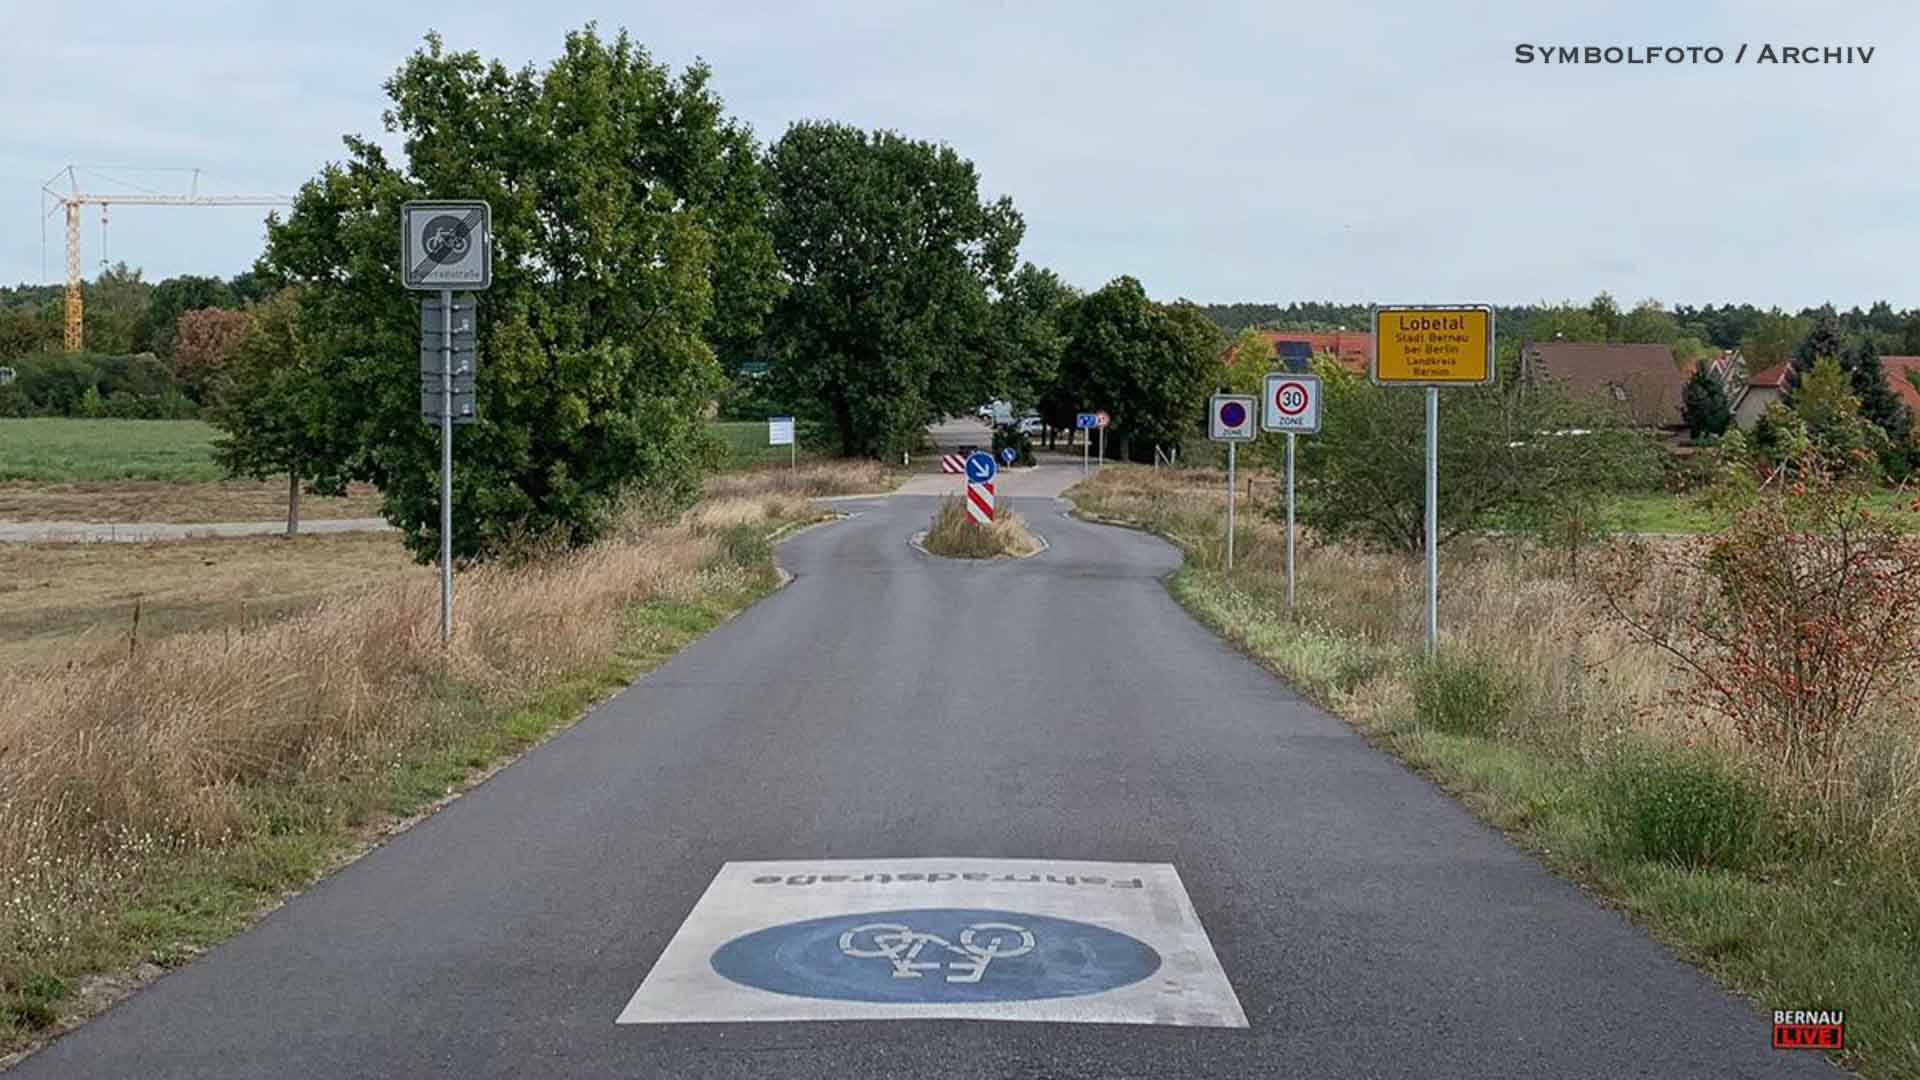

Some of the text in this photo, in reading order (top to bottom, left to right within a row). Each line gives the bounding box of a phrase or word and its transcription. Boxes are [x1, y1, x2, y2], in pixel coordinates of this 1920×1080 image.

[1400, 315, 1464, 331] Lobetal
[1395, 333, 1470, 343] Stadt Bernau
[1404, 344, 1459, 354] bei Berlin
[1406, 357, 1456, 366] Landkreis
[1282, 391, 1302, 407] 30
[1279, 417, 1304, 425] ZONE
[752, 872, 1142, 889] Fahrradstraße
